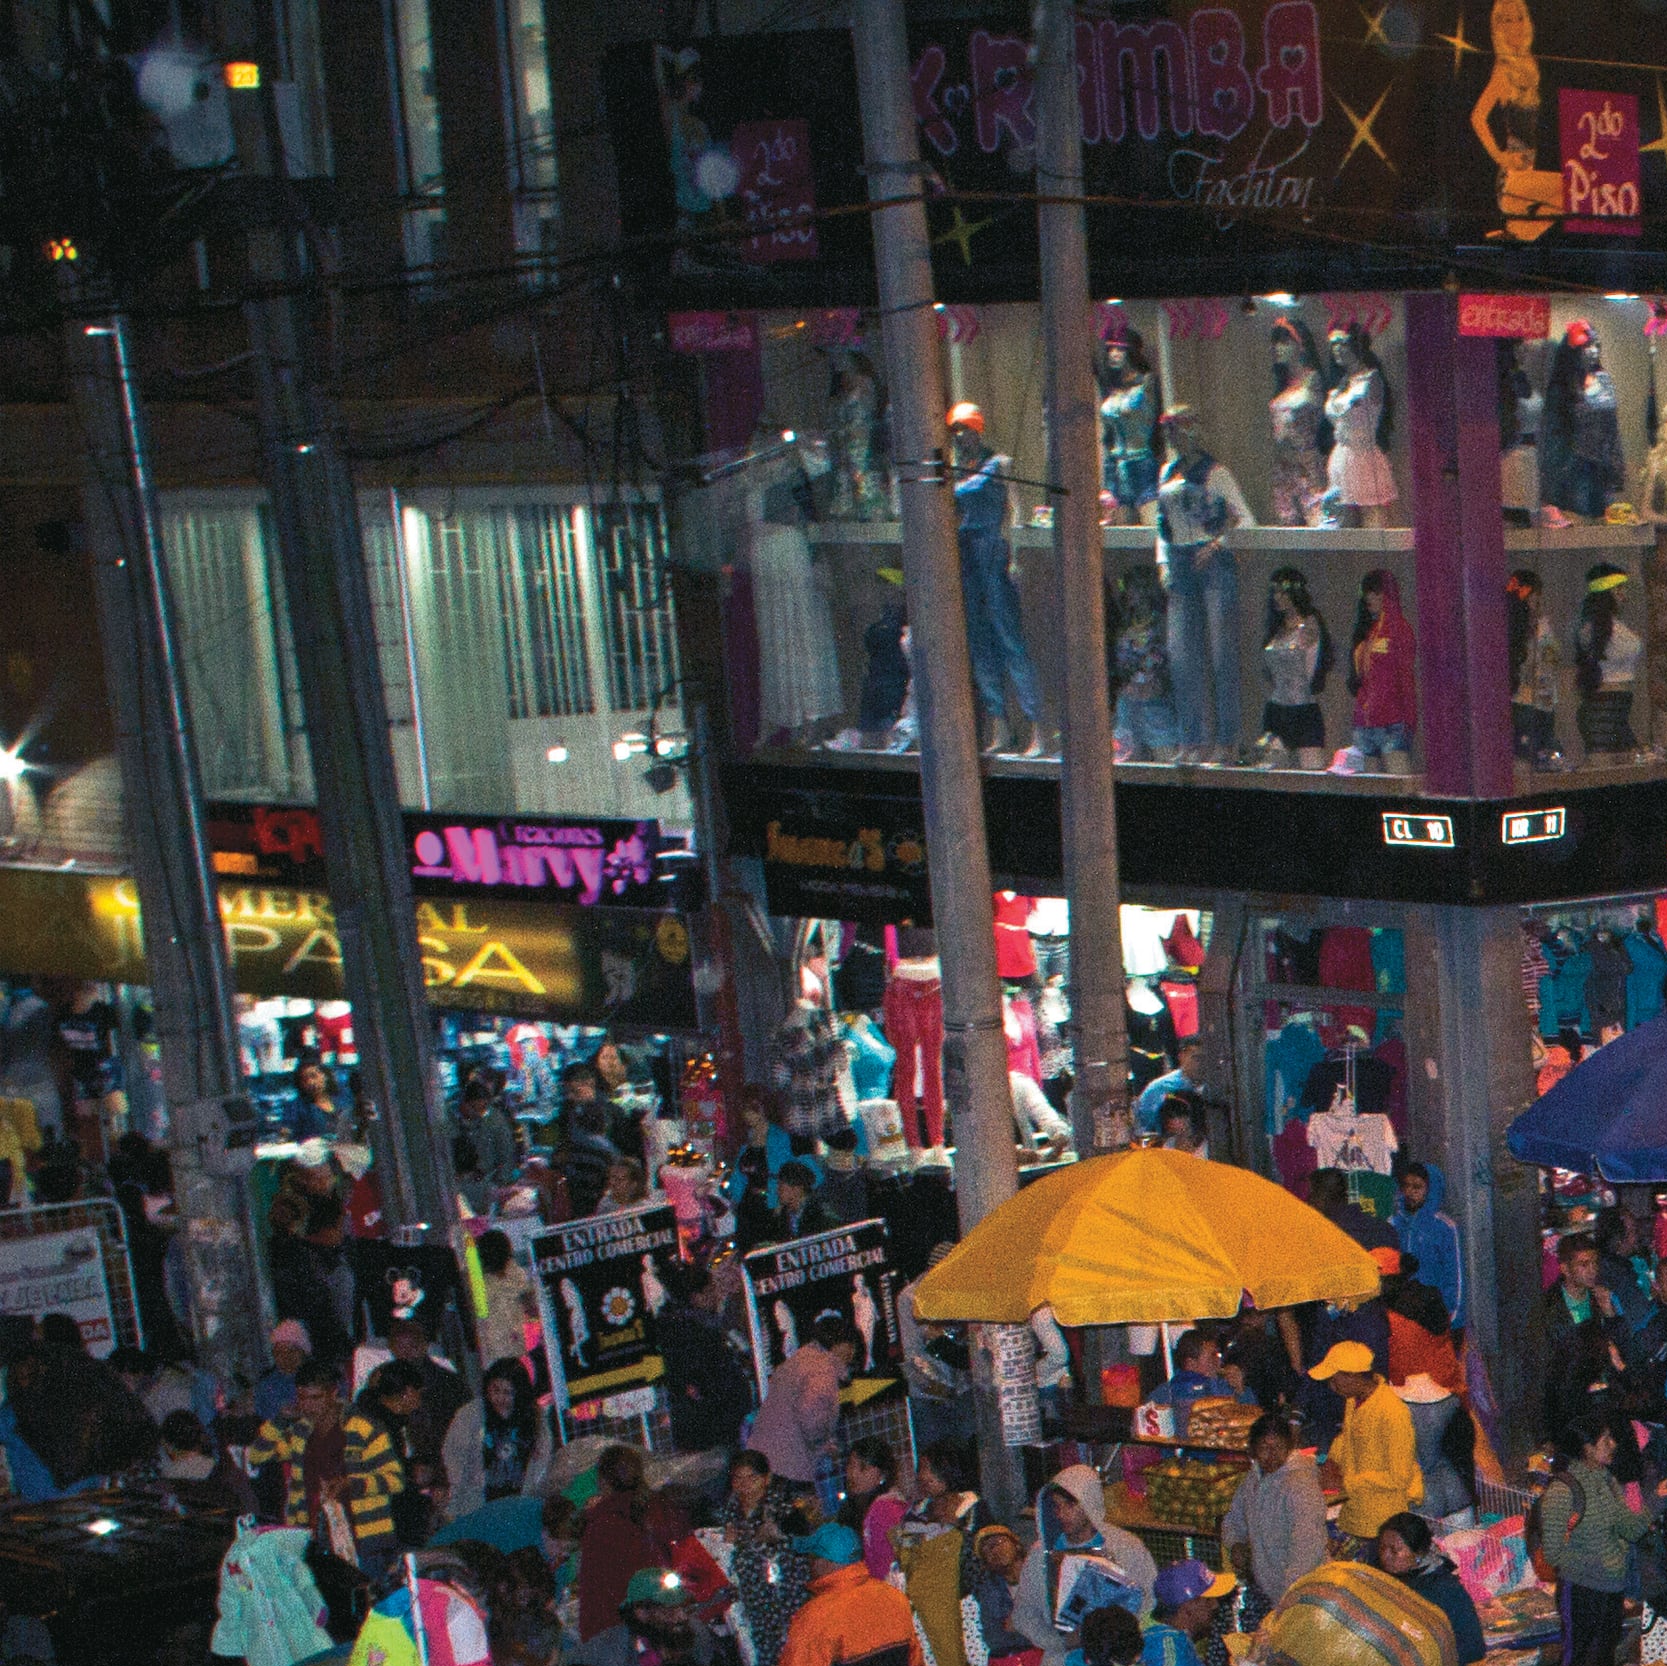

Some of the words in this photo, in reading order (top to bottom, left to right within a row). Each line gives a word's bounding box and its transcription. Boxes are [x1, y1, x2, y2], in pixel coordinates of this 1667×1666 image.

[1565, 158, 1640, 217] Piso
[1392, 818, 1413, 840] CL
[1427, 820, 1445, 841] 10
[1544, 814, 1557, 834] 11
[562, 1217, 646, 1252] ENTRADA
[596, 1229, 676, 1261] COMERCIAL
[775, 1235, 857, 1273] ENTRADA
[809, 1246, 887, 1282] COMERCIAL
